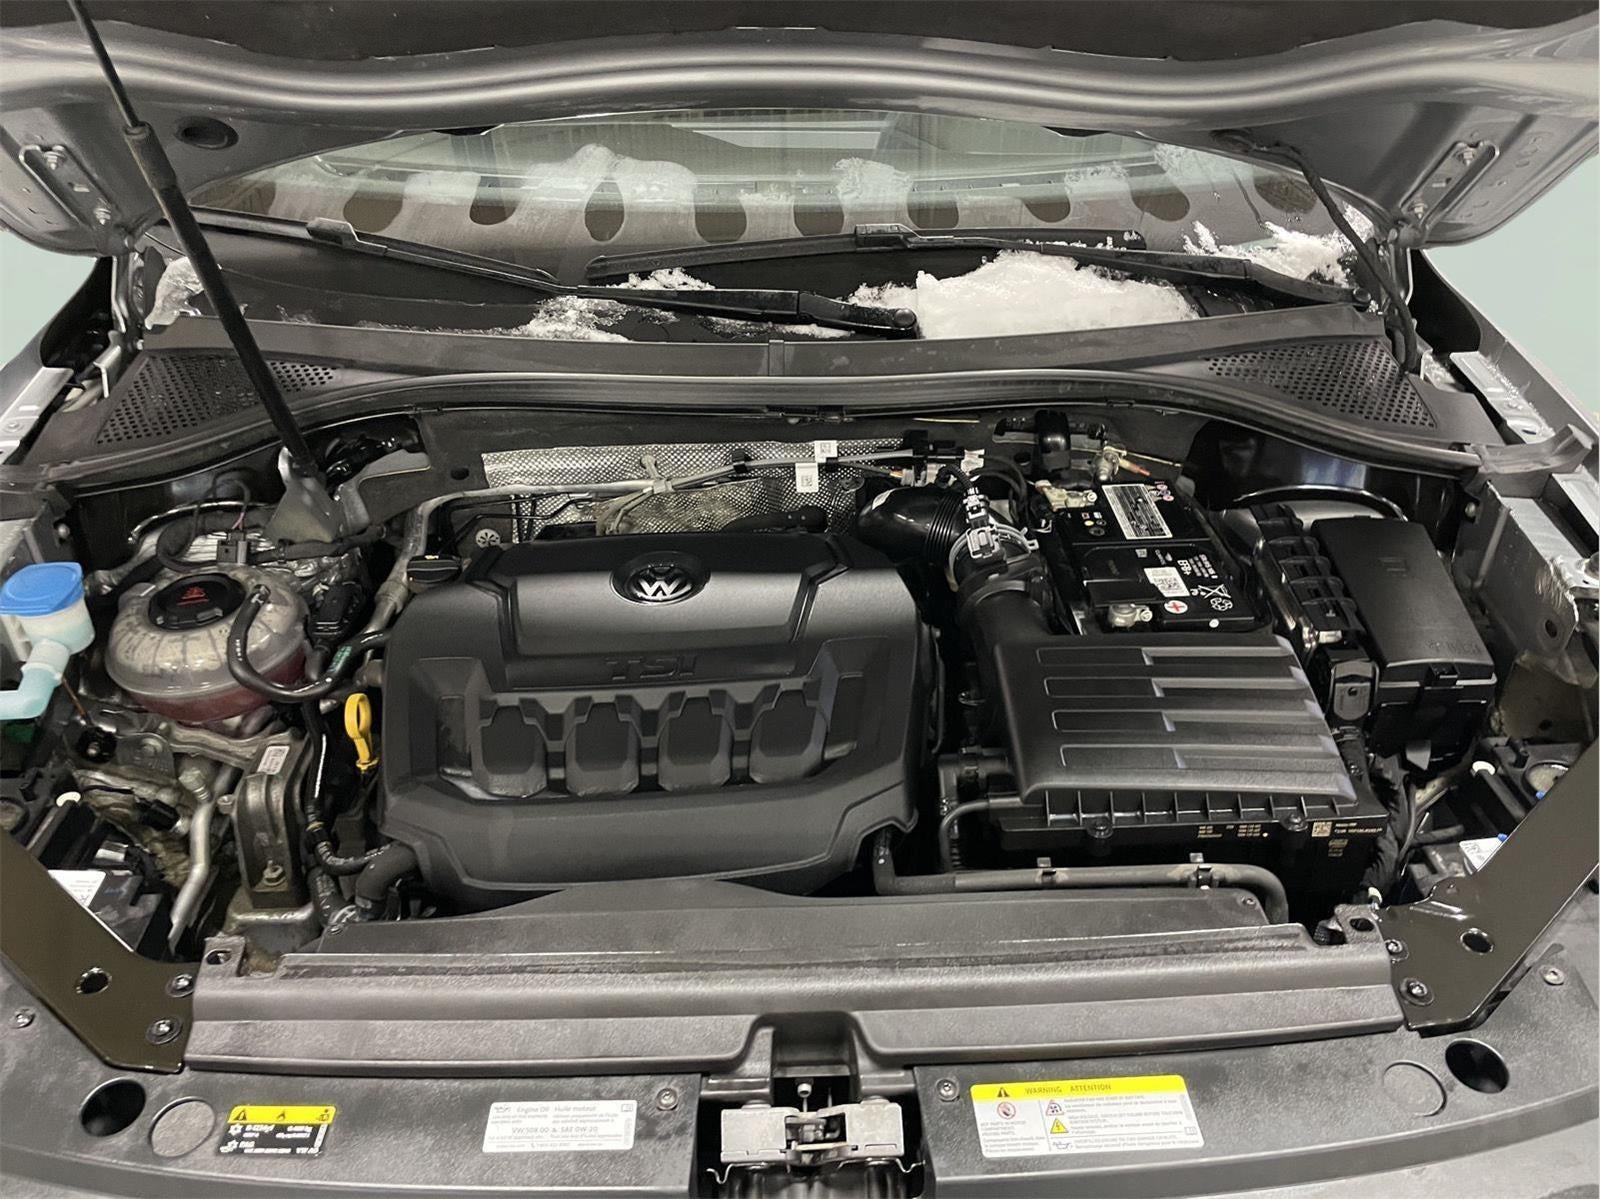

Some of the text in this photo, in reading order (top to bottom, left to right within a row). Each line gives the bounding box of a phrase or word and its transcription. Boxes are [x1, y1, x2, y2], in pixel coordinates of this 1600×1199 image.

[605, 655, 697, 681] TSI
[1025, 1083, 1112, 1095] WARNING ATTENTION
[516, 1106, 539, 1114] Engine
